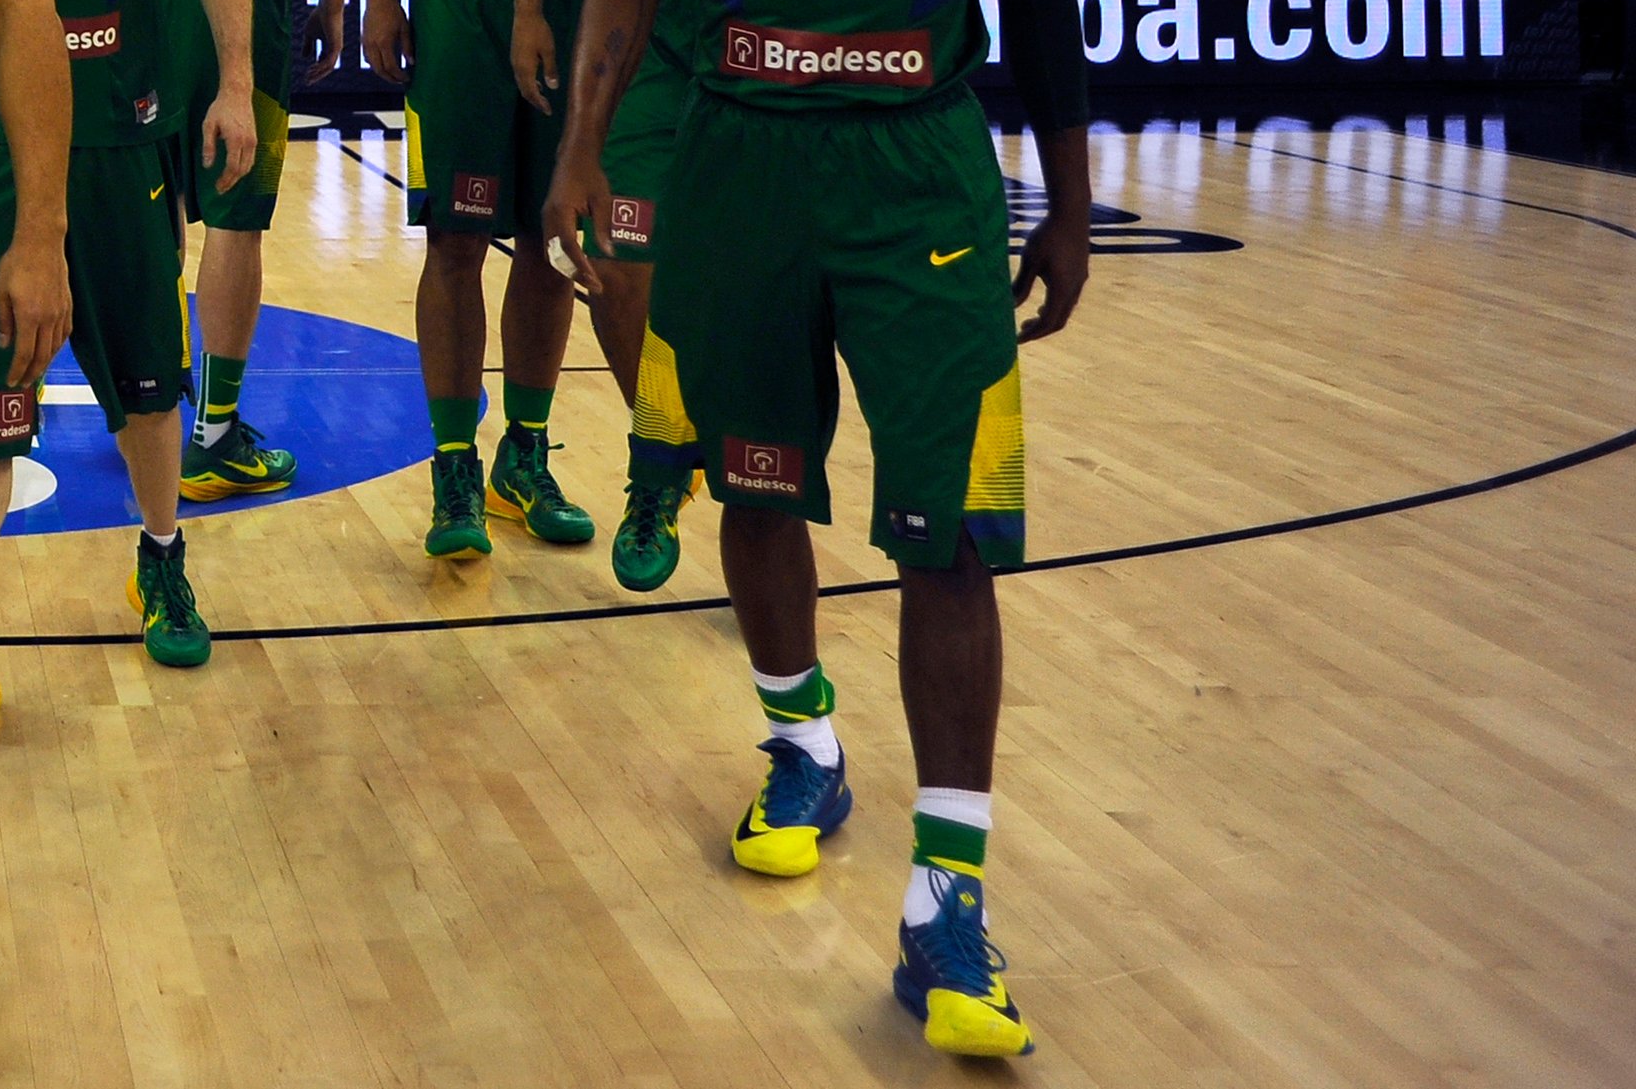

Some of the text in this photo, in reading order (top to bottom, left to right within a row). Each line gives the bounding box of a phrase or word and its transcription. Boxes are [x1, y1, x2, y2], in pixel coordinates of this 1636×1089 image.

[66, 27, 116, 50] esco
[764, 39, 924, 75] Bradesco
[454, 200, 494, 216] Bradesco
[611, 229, 648, 243] adesco
[139, 379, 158, 390] FIBA
[727, 471, 797, 493] Bradesco
